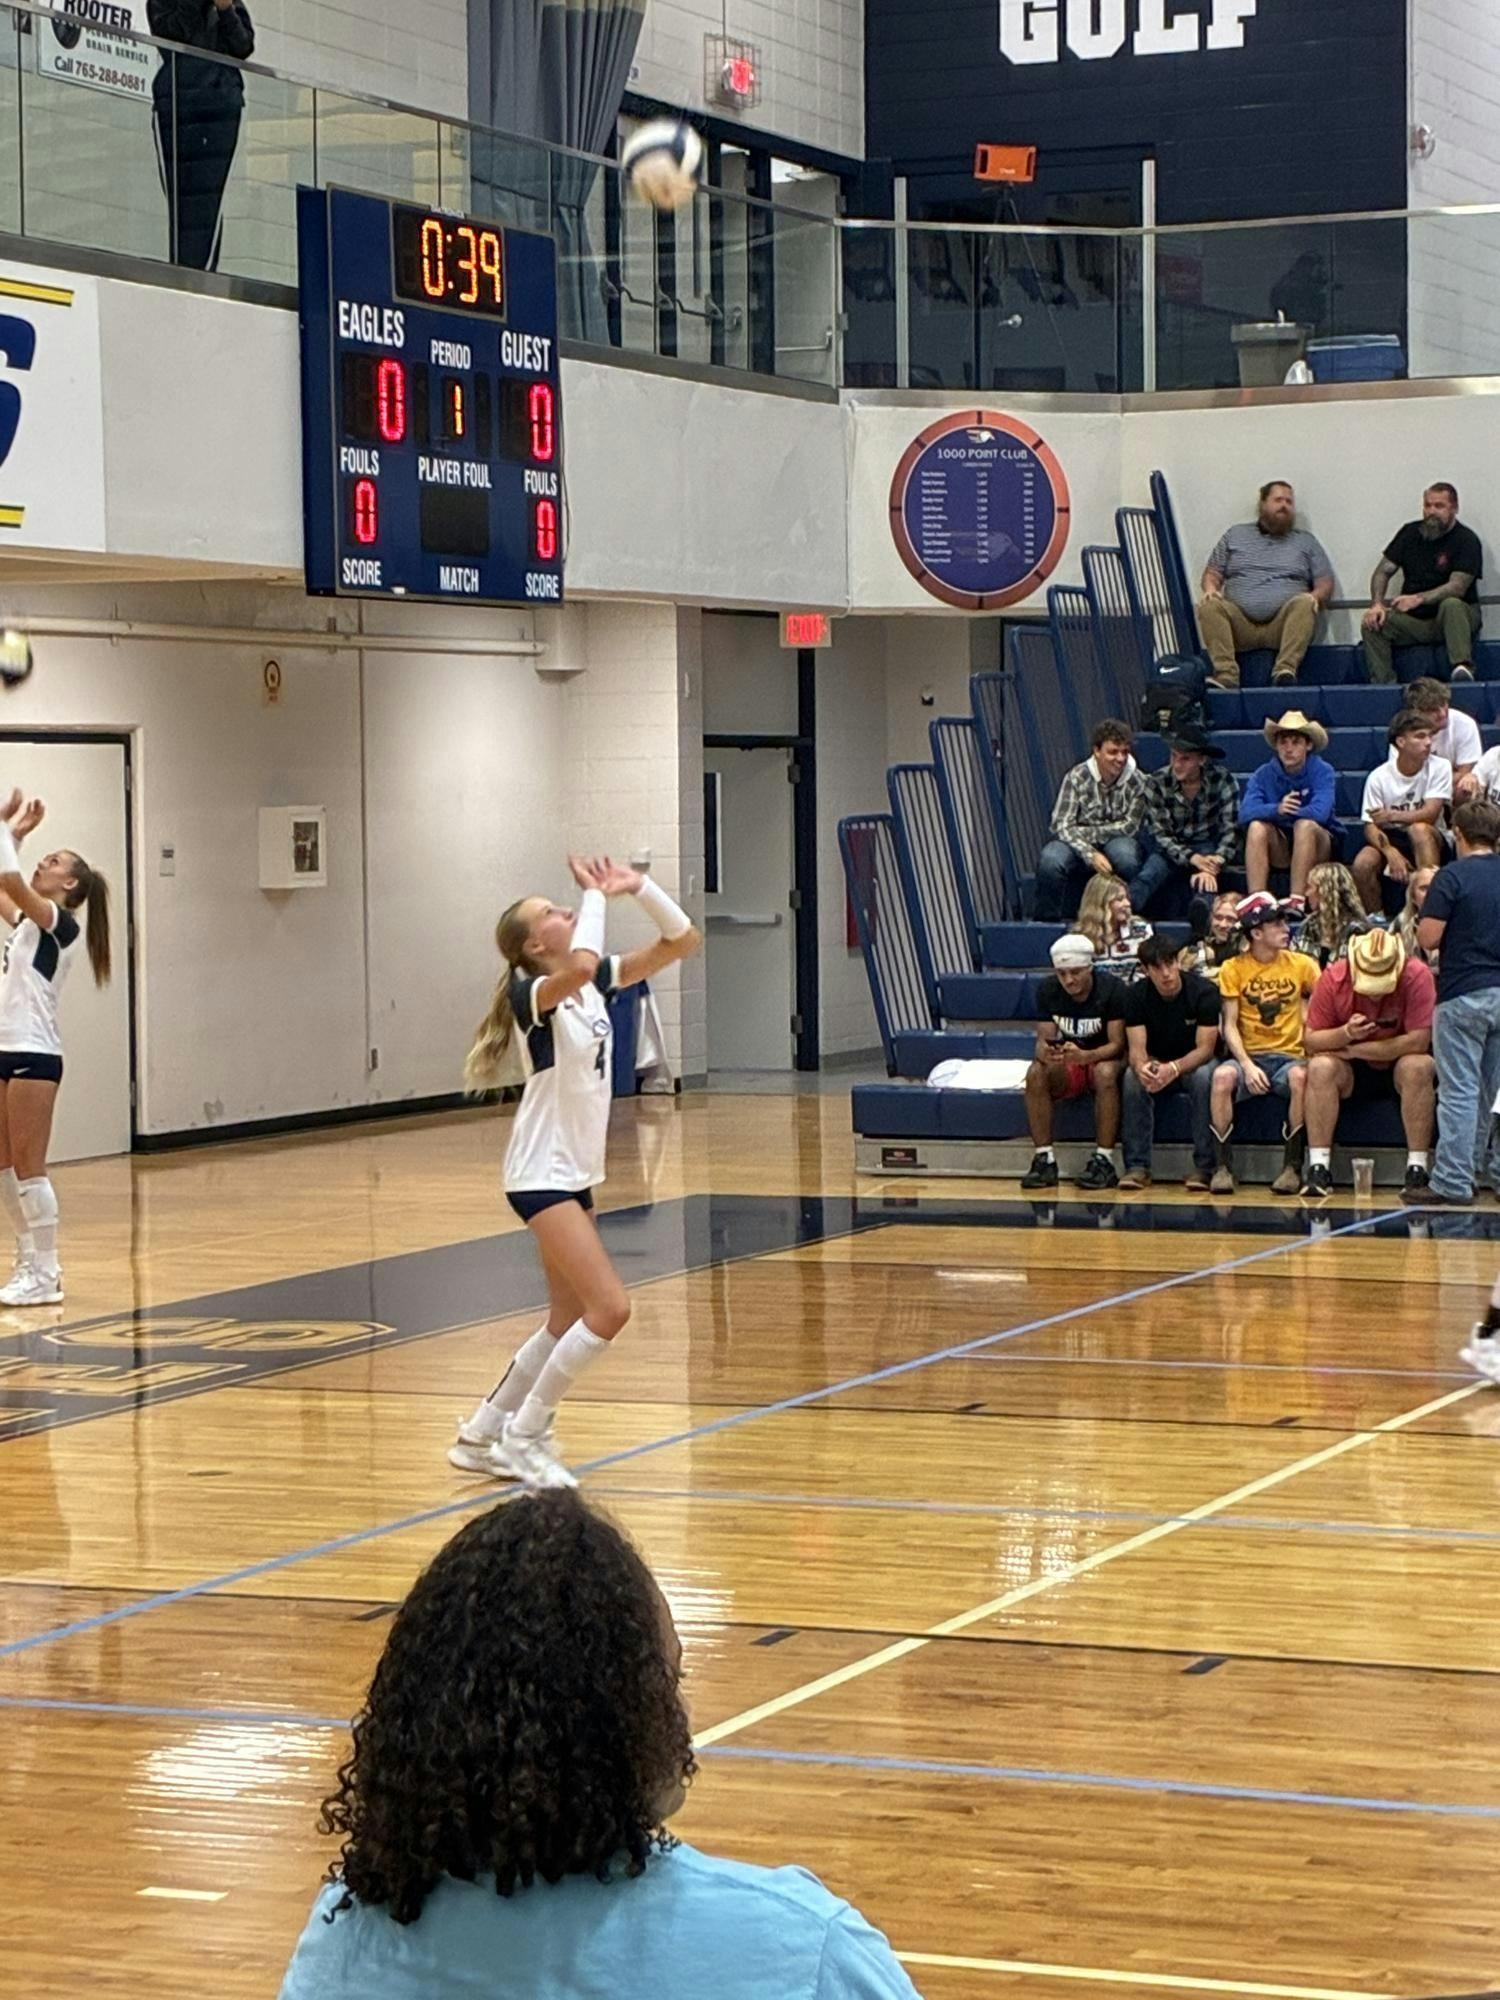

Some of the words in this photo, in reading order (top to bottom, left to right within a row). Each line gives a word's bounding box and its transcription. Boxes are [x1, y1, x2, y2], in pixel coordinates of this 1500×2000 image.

[64, 0, 132, 31] ROOTER
[999, 0, 1257, 65] GOLF
[54, 55, 74, 74] Call
[421, 218, 503, 304] 0:39
[339, 300, 405, 349] EAGLES
[430, 339, 472, 370] PERIOD
[501, 331, 552, 373] GUEST
[378, 359, 405, 442] 0
[454, 383, 464, 436] 1
[529, 383, 555, 462] 0
[341, 446, 380, 476] FOULS
[937, 448, 966, 459] 1000
[968, 448, 998, 459] POINT
[1000, 448, 1028, 460] CLUB
[418, 456, 461, 486] PLAYER
[463, 461, 492, 489] FOUL
[524, 468, 558, 497] FOULS
[354, 478, 378, 544] 0
[536, 500, 556, 560] 0
[343, 558, 382, 587] SCORE
[439, 565, 480, 593] MATCH
[526, 571, 559, 599] SCORE
[787, 613, 823, 645] EXIT
